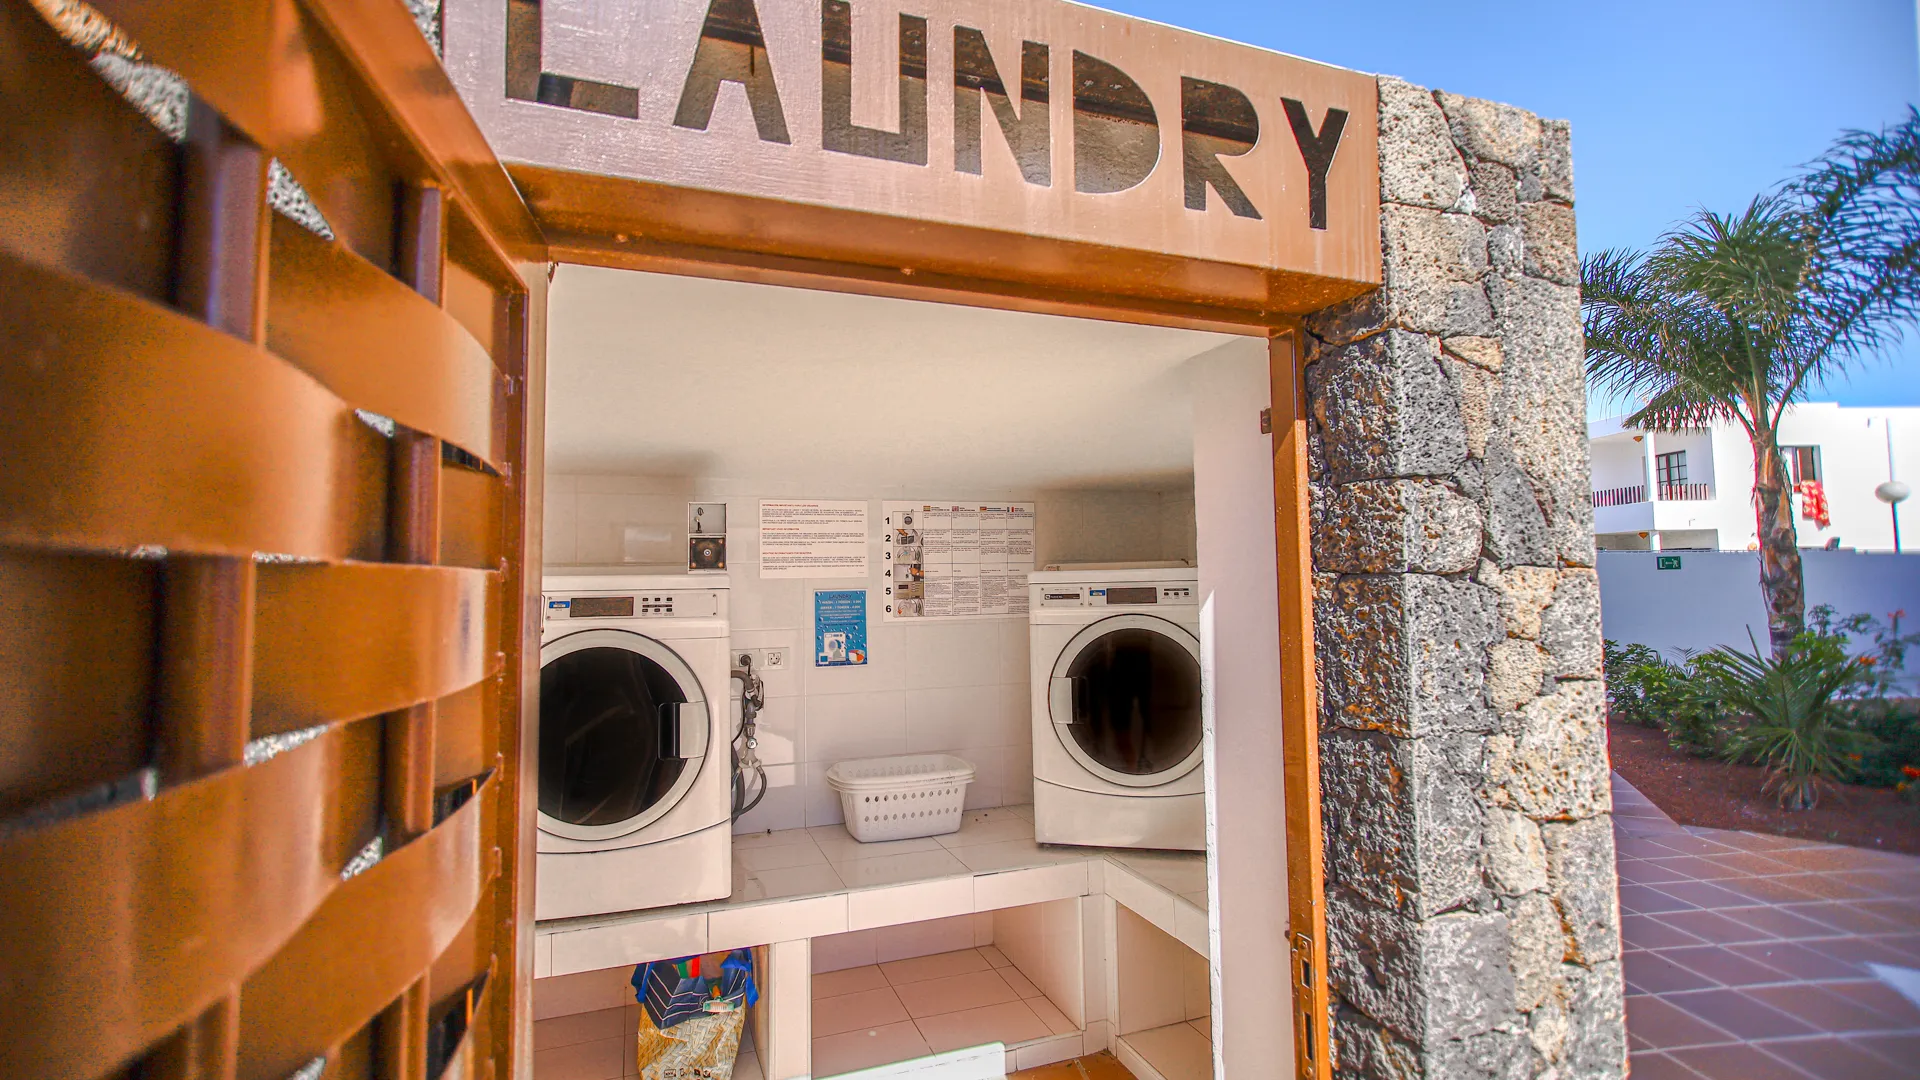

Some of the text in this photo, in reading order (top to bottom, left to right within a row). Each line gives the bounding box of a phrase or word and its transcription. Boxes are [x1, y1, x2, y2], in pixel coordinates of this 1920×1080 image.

[506, 0, 1350, 230] LAUNDRY
[884, 516, 890, 525] 1
[885, 534, 892, 543] 2
[885, 551, 892, 560] 3
[884, 569, 892, 578] 4
[885, 587, 892, 595] 5
[885, 604, 892, 613] 6
